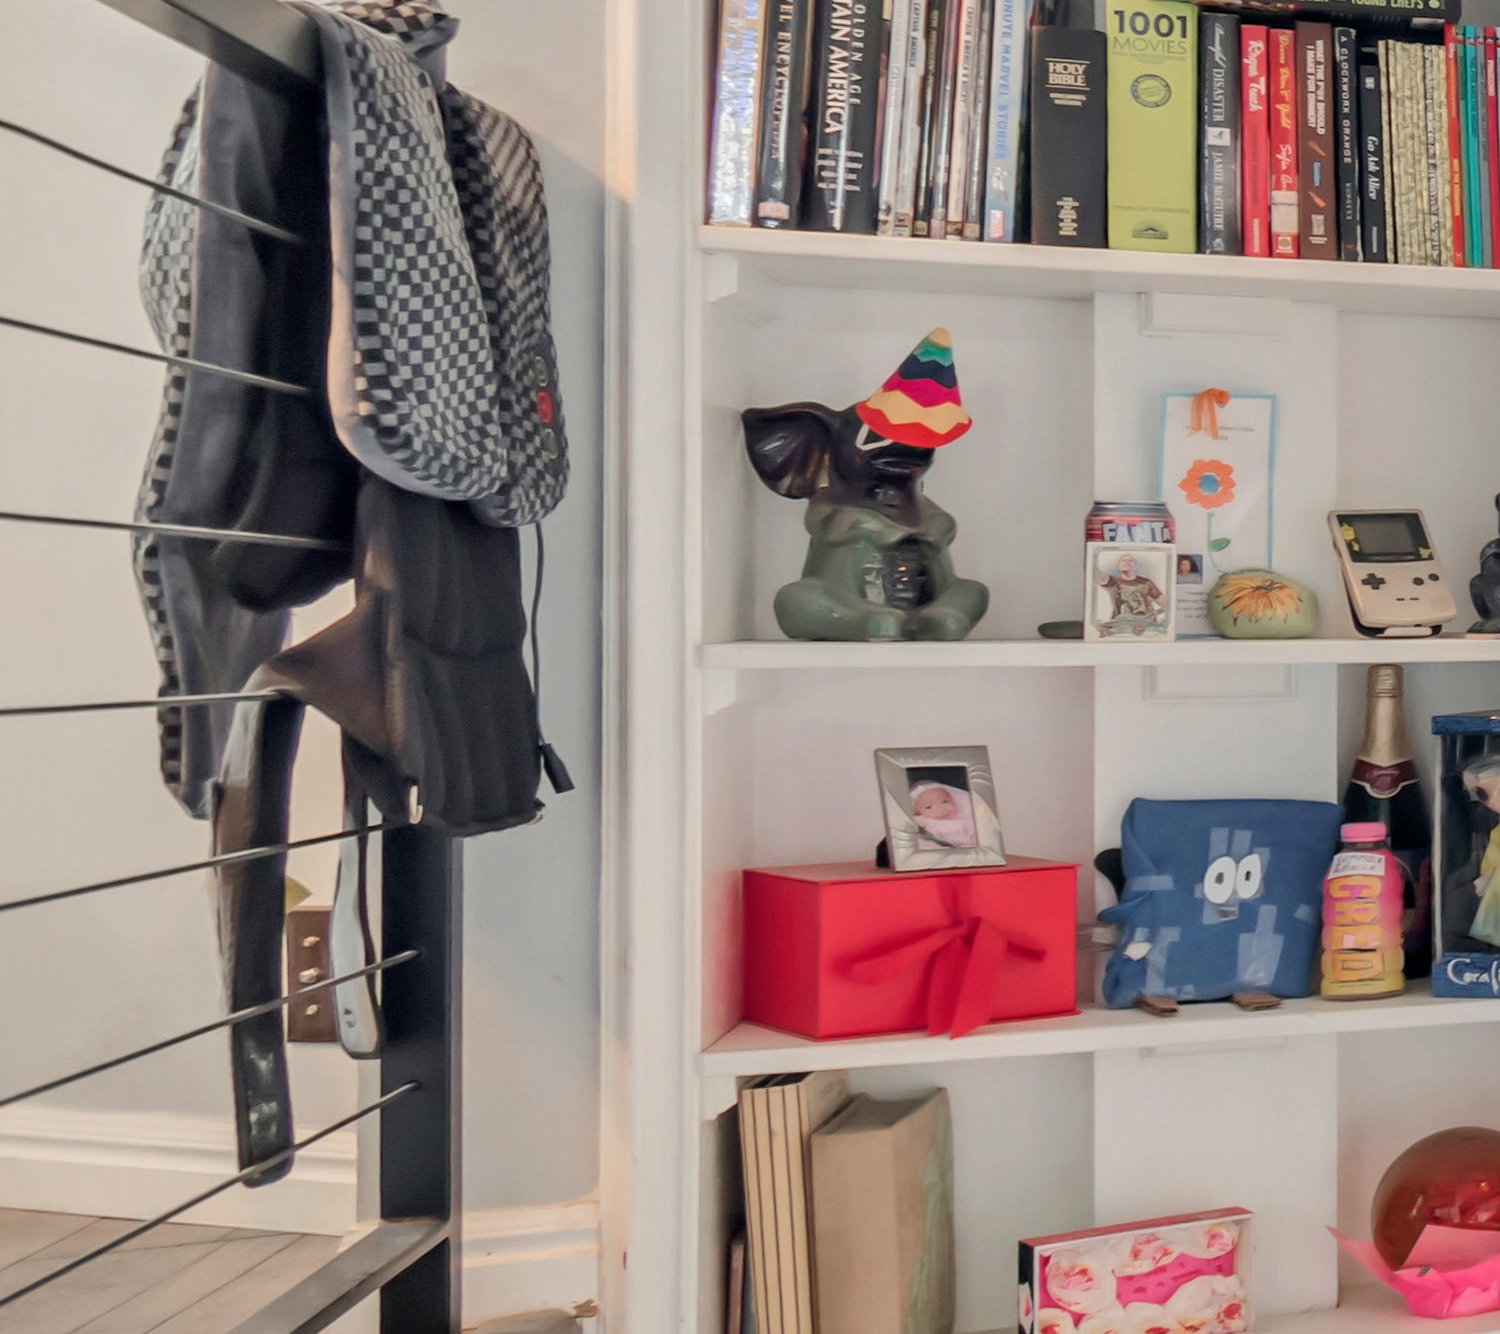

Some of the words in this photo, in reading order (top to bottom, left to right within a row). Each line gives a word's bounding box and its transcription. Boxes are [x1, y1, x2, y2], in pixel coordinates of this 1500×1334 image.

[1113, 10, 1188, 38] 1001
[1112, 37, 1188, 55] MOVIES
[1315, 40, 1325, 63] WHAT
[998, 44, 1012, 97] MARVEL
[1049, 63, 1087, 75] HOLY
[1049, 73, 1086, 86] BIBLE
[1316, 64, 1325, 80] THE
[1341, 48, 1350, 113] CLOCKWORK
[824, 46, 850, 134] AMERICA
[849, 72, 863, 105] AGE
[1212, 68, 1225, 122] DISASTER
[995, 104, 1008, 159] STORIES
[1316, 102, 1326, 135] SHOULD
[1343, 119, 1352, 164] ORANGE
[1367, 136, 1379, 152] Go
[1368, 154, 1379, 172] Ask
[1368, 174, 1380, 199] Alice
